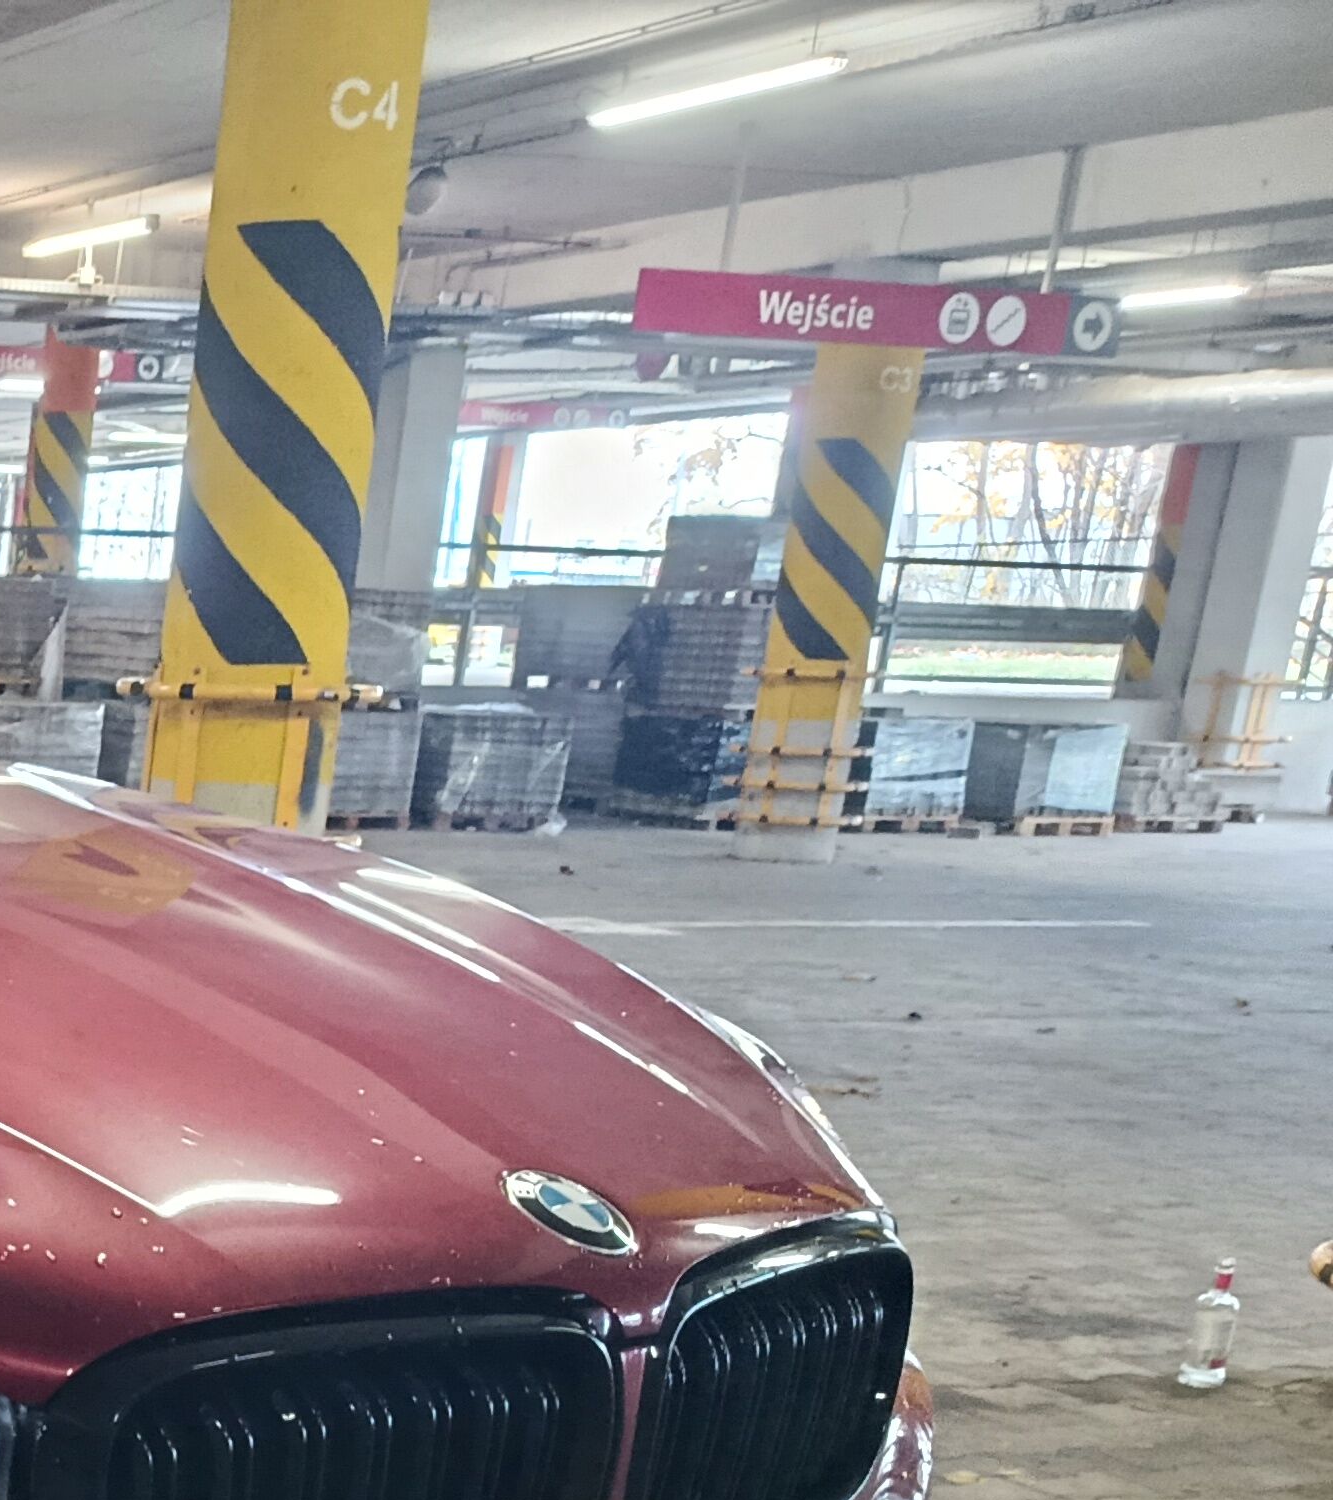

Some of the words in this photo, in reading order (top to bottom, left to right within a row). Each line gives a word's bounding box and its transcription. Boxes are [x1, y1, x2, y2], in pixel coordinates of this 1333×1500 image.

[330, 78, 399, 130] C4
[759, 289, 874, 334] Wejście
[880, 366, 913, 393] C3
